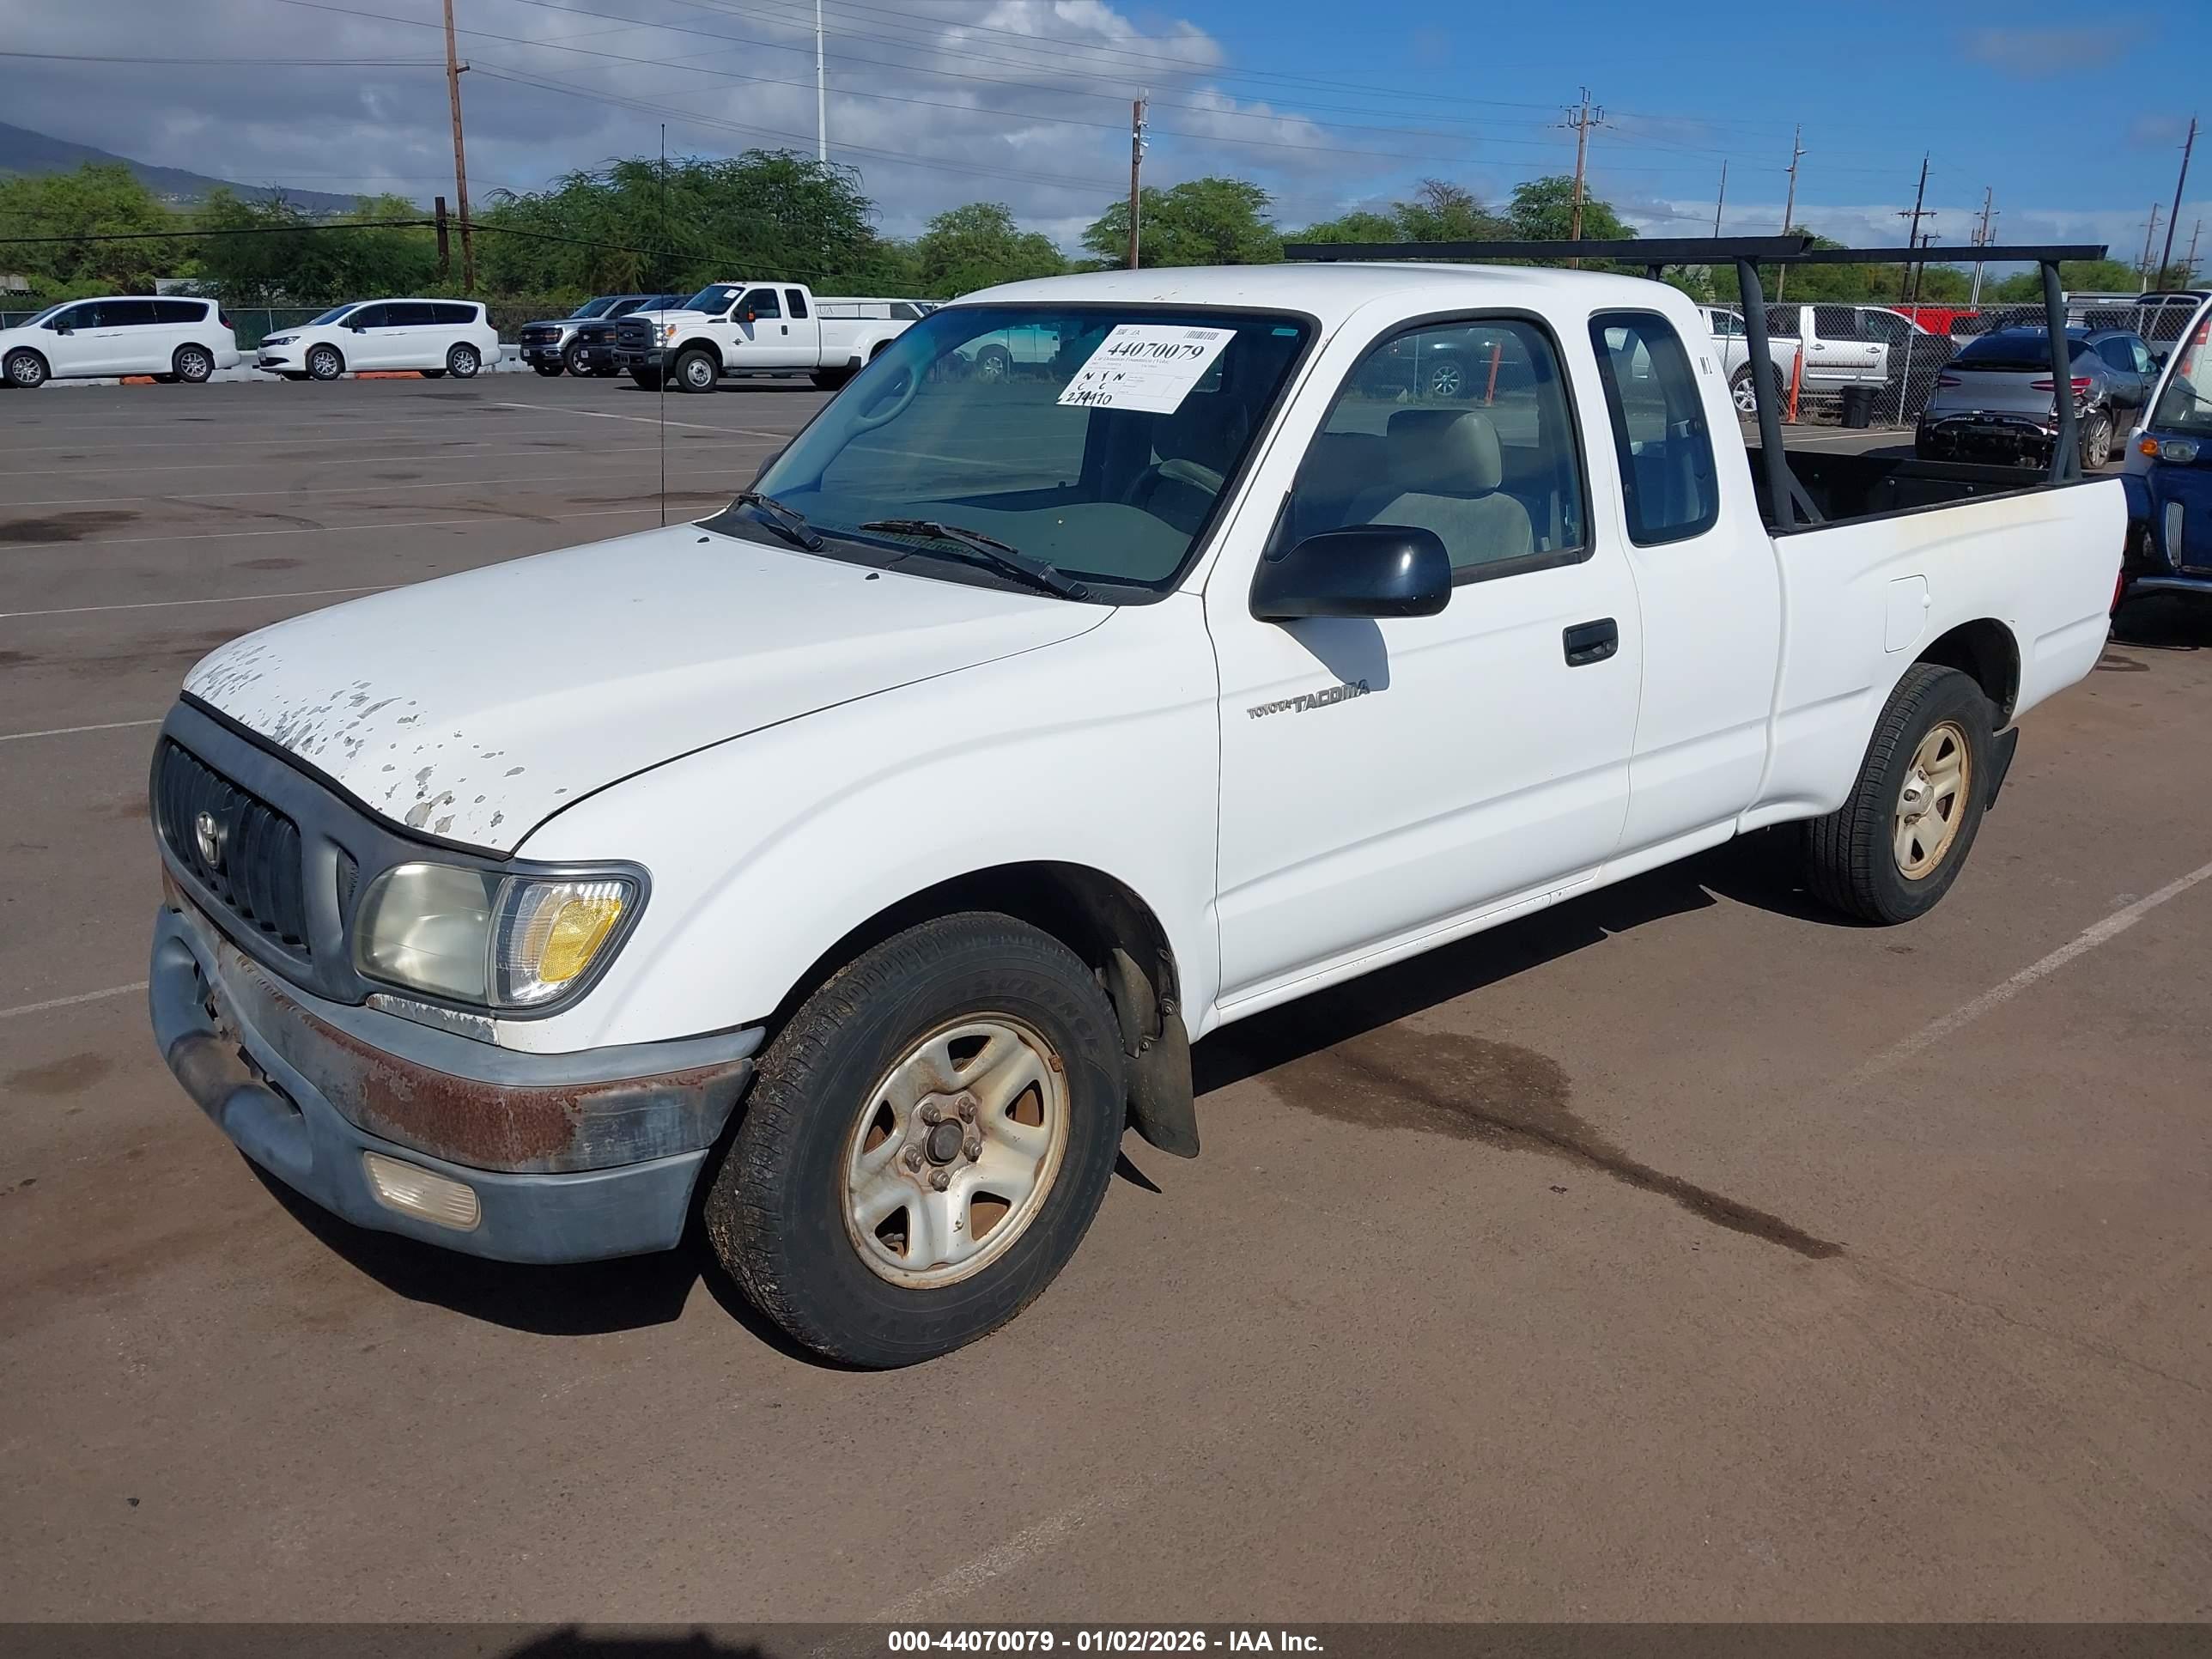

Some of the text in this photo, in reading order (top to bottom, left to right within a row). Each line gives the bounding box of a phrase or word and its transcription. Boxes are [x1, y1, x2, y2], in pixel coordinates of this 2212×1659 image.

[1108, 342, 1205, 361] 44070079
[1083, 372, 1096, 380] N
[1101, 371, 1109, 381] Y
[1113, 372, 1126, 381] N
[1247, 679, 1371, 719] TOYOTA TACOMA
